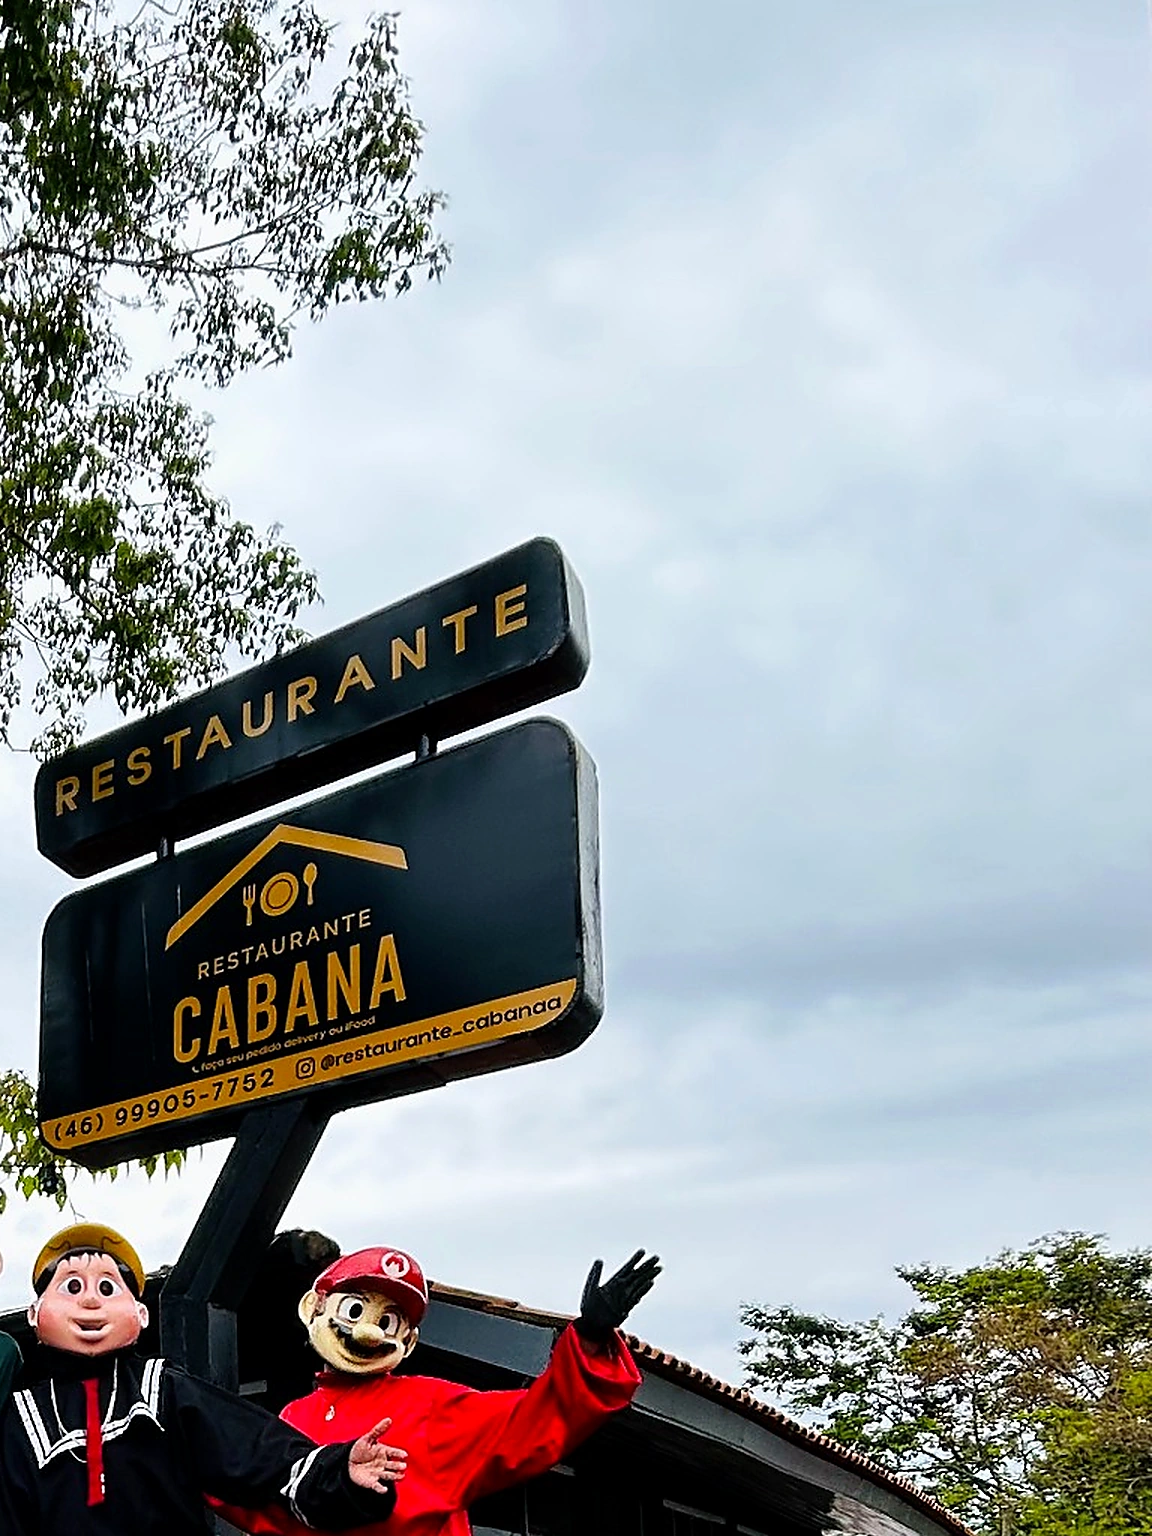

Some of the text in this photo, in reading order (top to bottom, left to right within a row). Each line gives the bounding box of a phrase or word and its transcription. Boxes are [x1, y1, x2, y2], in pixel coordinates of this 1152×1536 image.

[54, 583, 529, 817] RESTAURANTE
[197, 907, 372, 980] RESTAURANTE
[173, 933, 407, 1064] CABANA
[320, 994, 562, 1072] @restaurante_cabanaa
[226, 1051, 245, 1065] seu
[246, 1041, 282, 1061] pedido
[283, 1030, 327, 1048] delivery
[328, 1026, 344, 1037] ou
[54, 1067, 275, 1142] (46) 99905-7752
